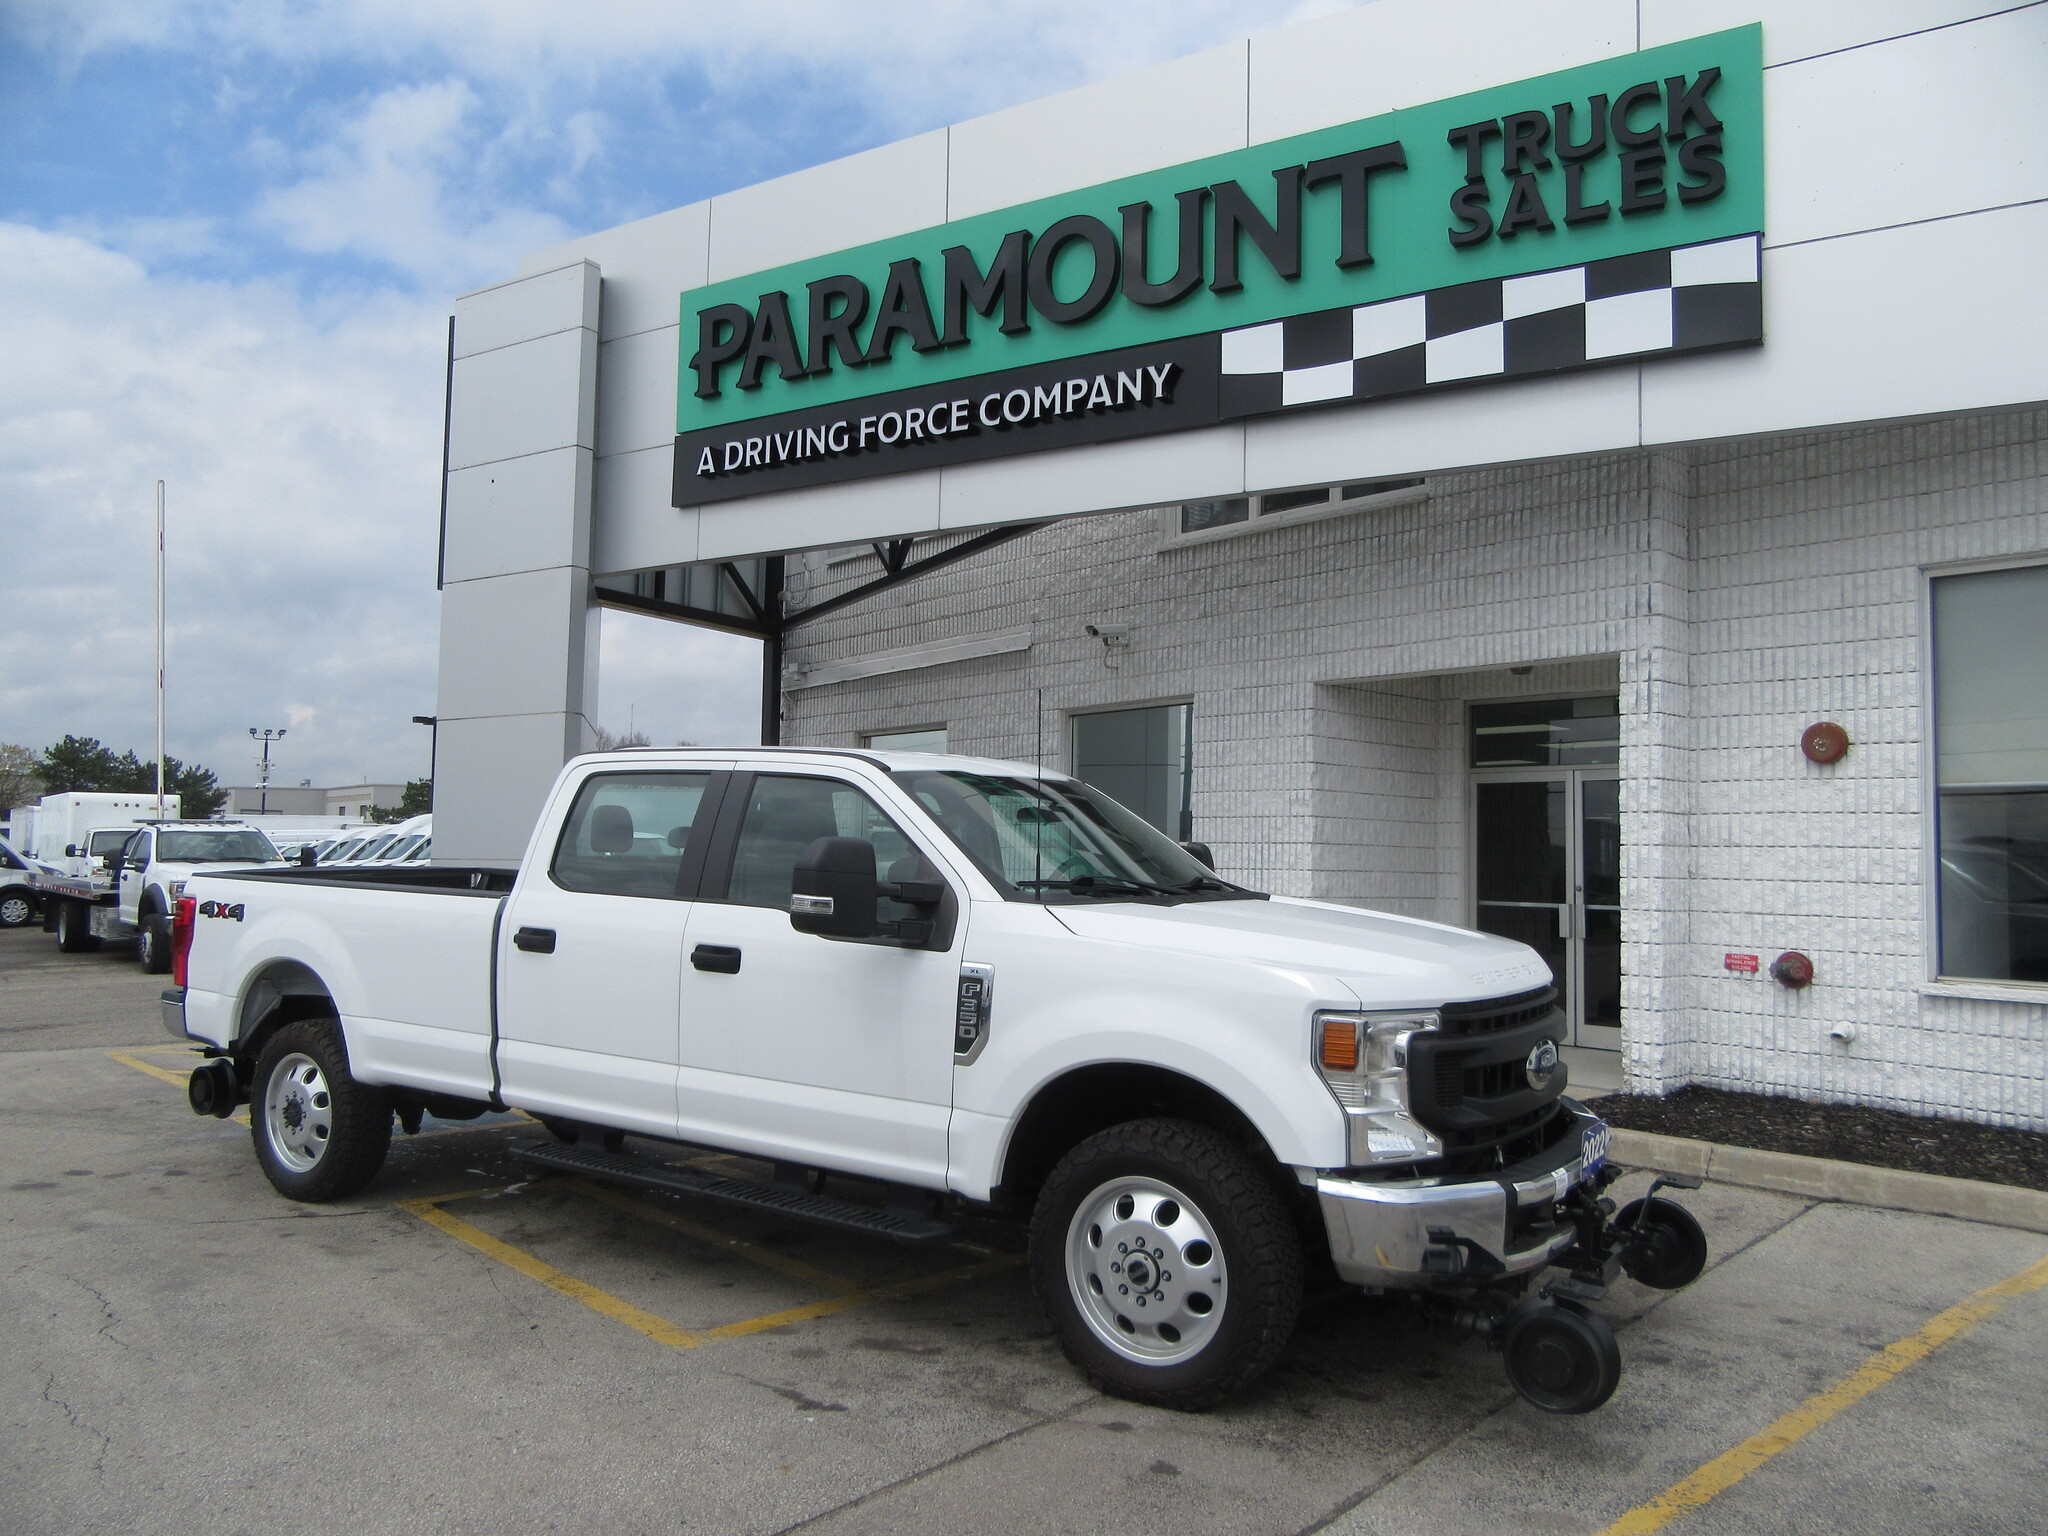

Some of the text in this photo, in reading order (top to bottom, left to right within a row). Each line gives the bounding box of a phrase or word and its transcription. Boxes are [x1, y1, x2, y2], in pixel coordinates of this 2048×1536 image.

[1447, 66, 1723, 184] TRUCK
[1447, 133, 1727, 248] SALES
[689, 140, 1408, 399] PARAMOUNT
[696, 362, 1175, 476] A DRIVING FORCE COMPANY
[1583, 1130, 1605, 1169] 2022
